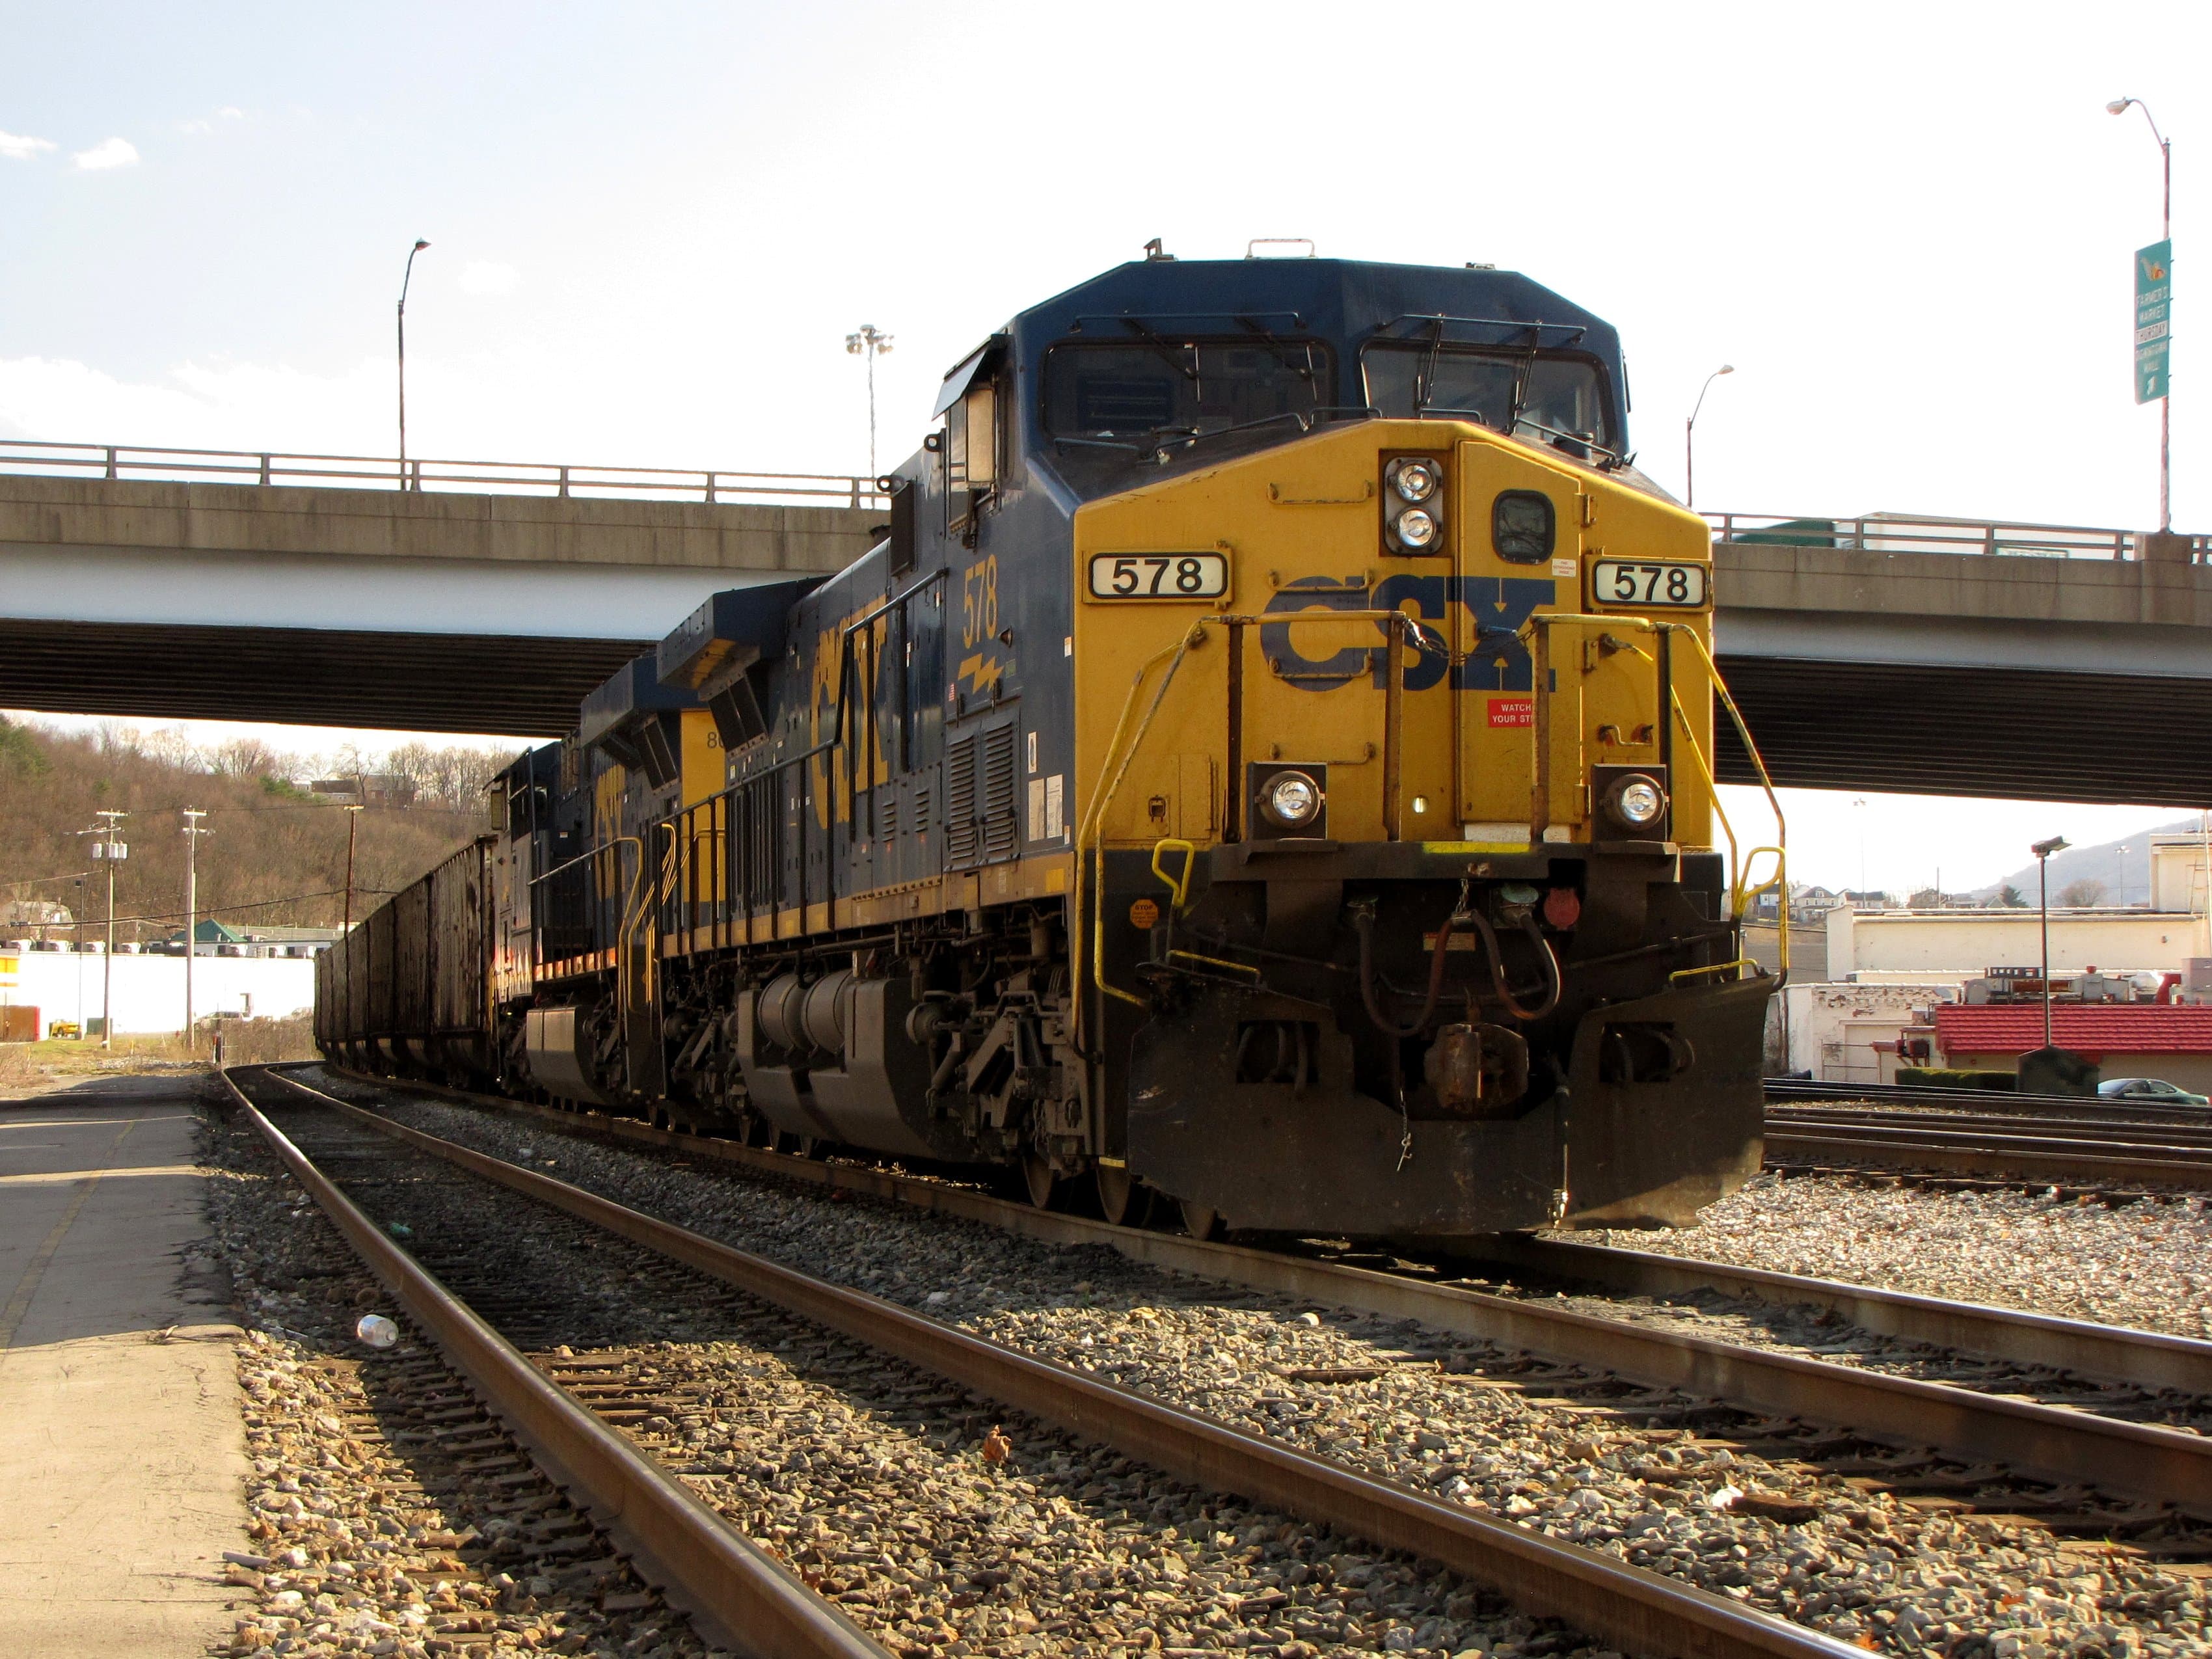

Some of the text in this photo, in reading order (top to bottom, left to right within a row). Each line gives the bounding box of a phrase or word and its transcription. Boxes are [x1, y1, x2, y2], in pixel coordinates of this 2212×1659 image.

[964, 554, 997, 649] 578
[1113, 558, 1202, 594] 578
[1614, 565, 1688, 602] 578
[1260, 574, 1556, 693] CSX
